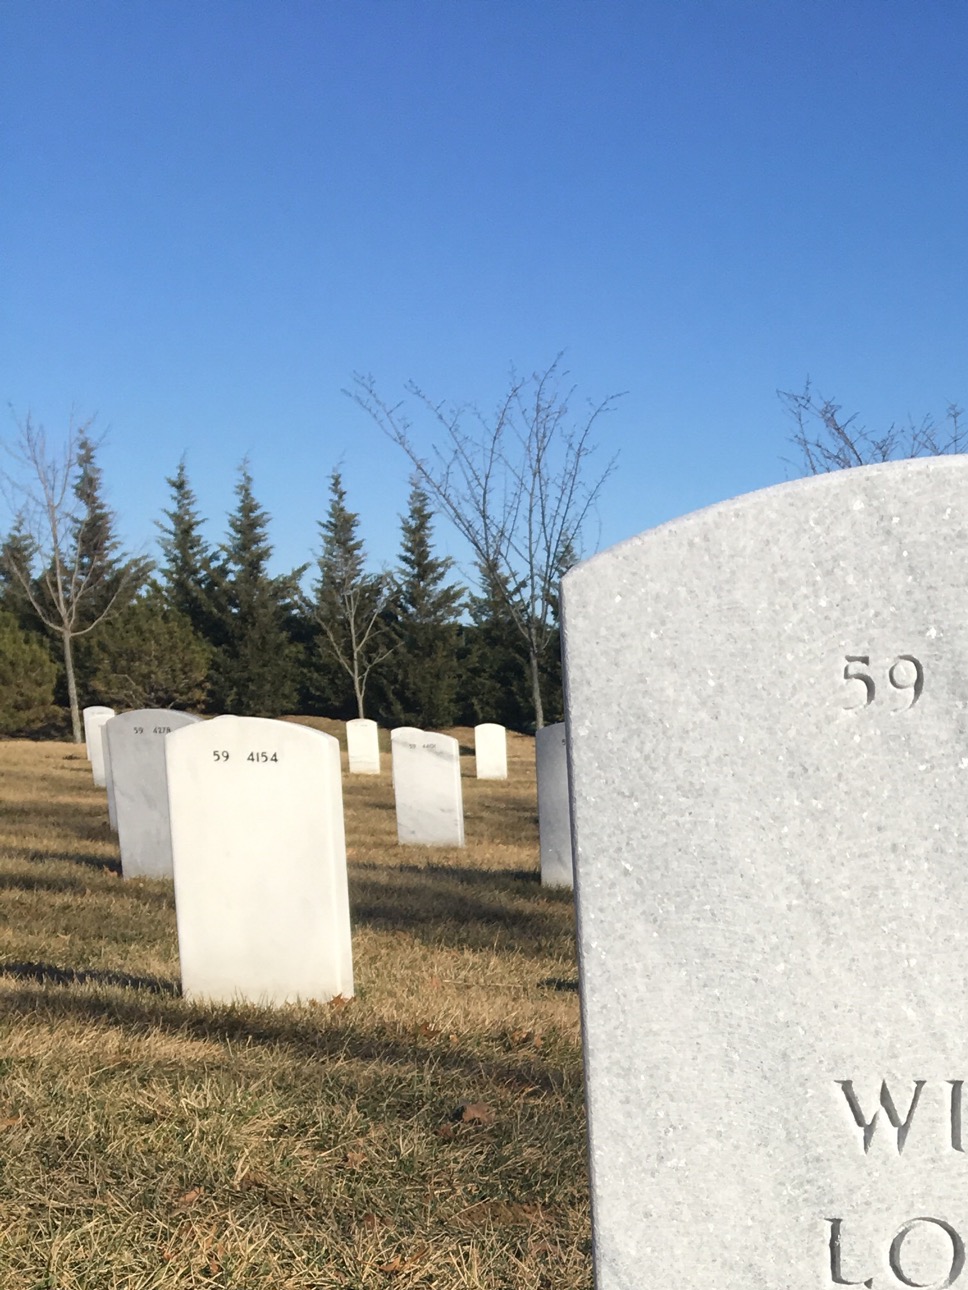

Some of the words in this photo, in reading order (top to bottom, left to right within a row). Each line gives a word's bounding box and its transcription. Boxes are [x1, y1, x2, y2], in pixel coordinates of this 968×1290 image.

[843, 654, 925, 712] 59
[213, 750, 230, 762] 59
[246, 751, 279, 763] 4154
